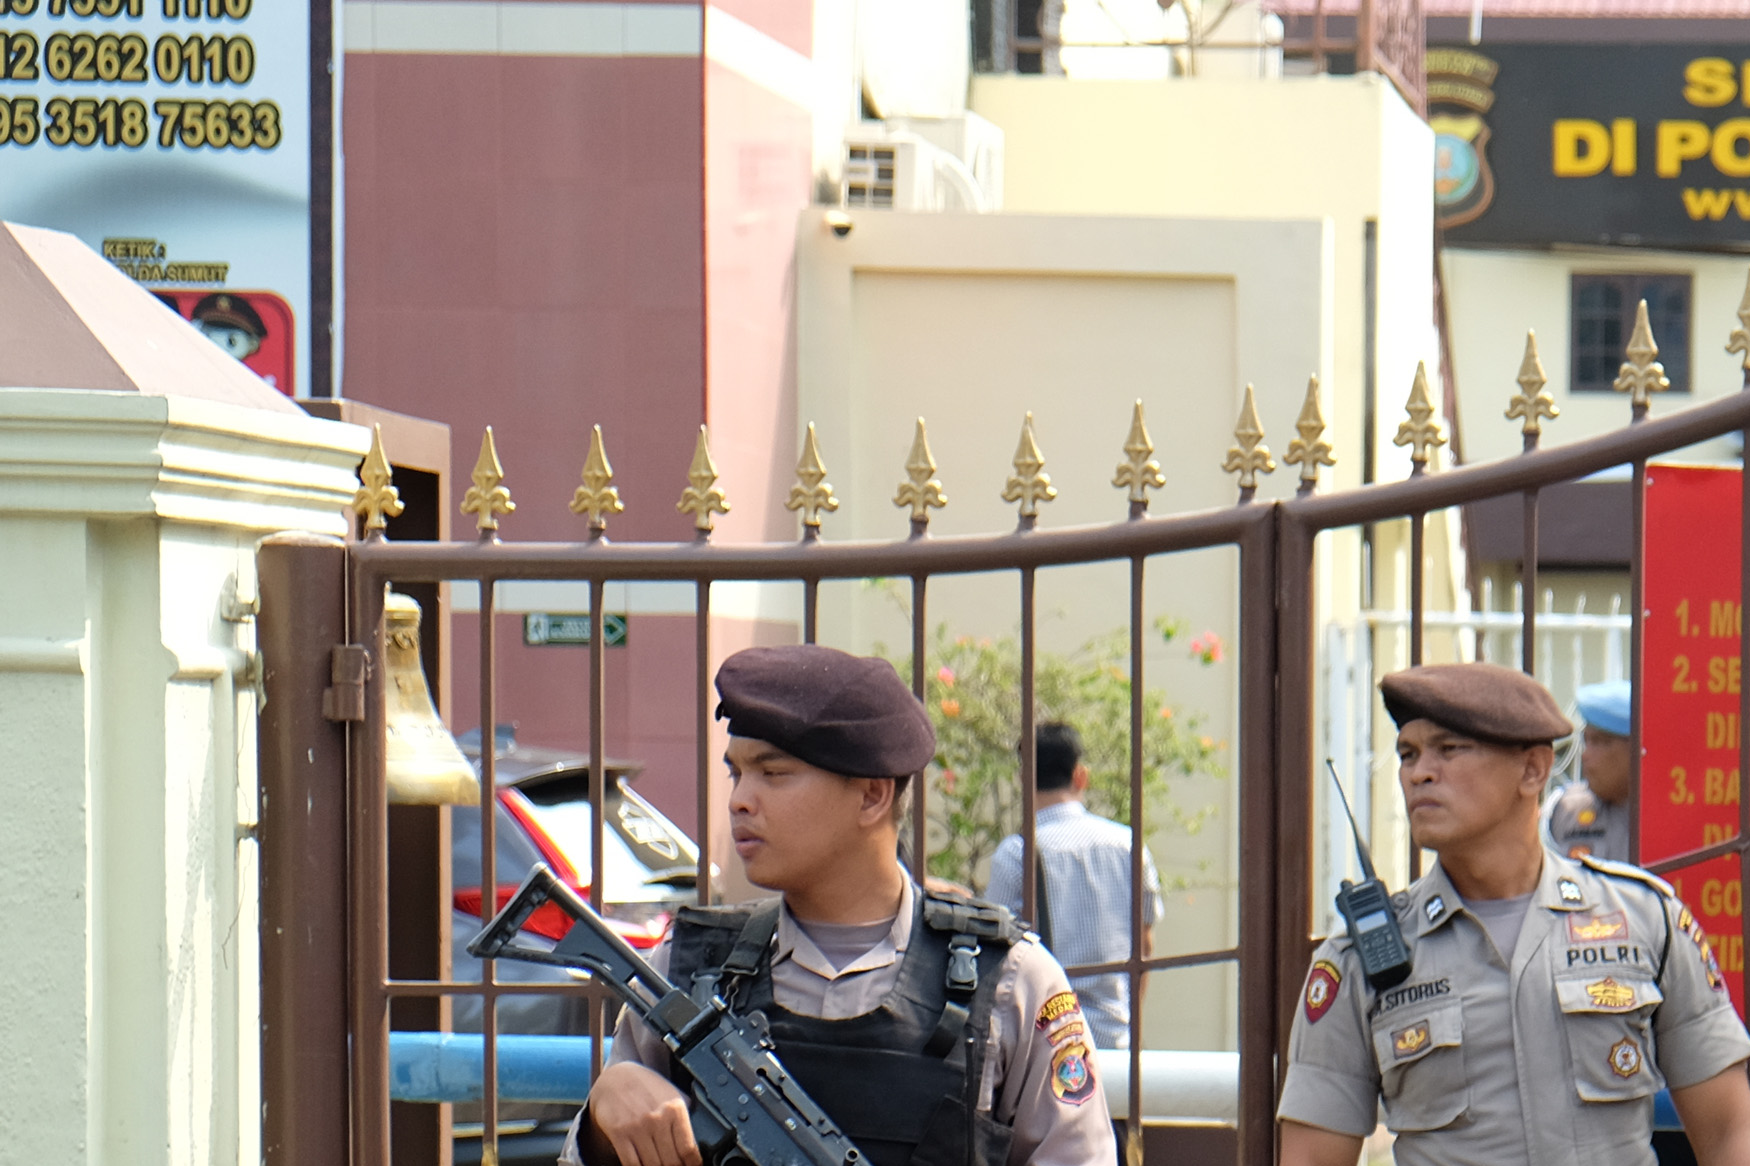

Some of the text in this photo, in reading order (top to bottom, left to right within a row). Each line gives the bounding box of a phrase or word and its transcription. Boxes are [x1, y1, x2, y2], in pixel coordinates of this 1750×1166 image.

[45, 33, 148, 81] 6262
[154, 35, 254, 83] 0110
[45, 99, 148, 147] 3518
[154, 101, 280, 149] 75633
[1553, 119, 1637, 177] DI
[1675, 599, 1700, 638] 1.
[1671, 654, 1699, 694] 2.
[1669, 766, 1696, 805] 3.
[1566, 945, 1639, 967] POLRI
